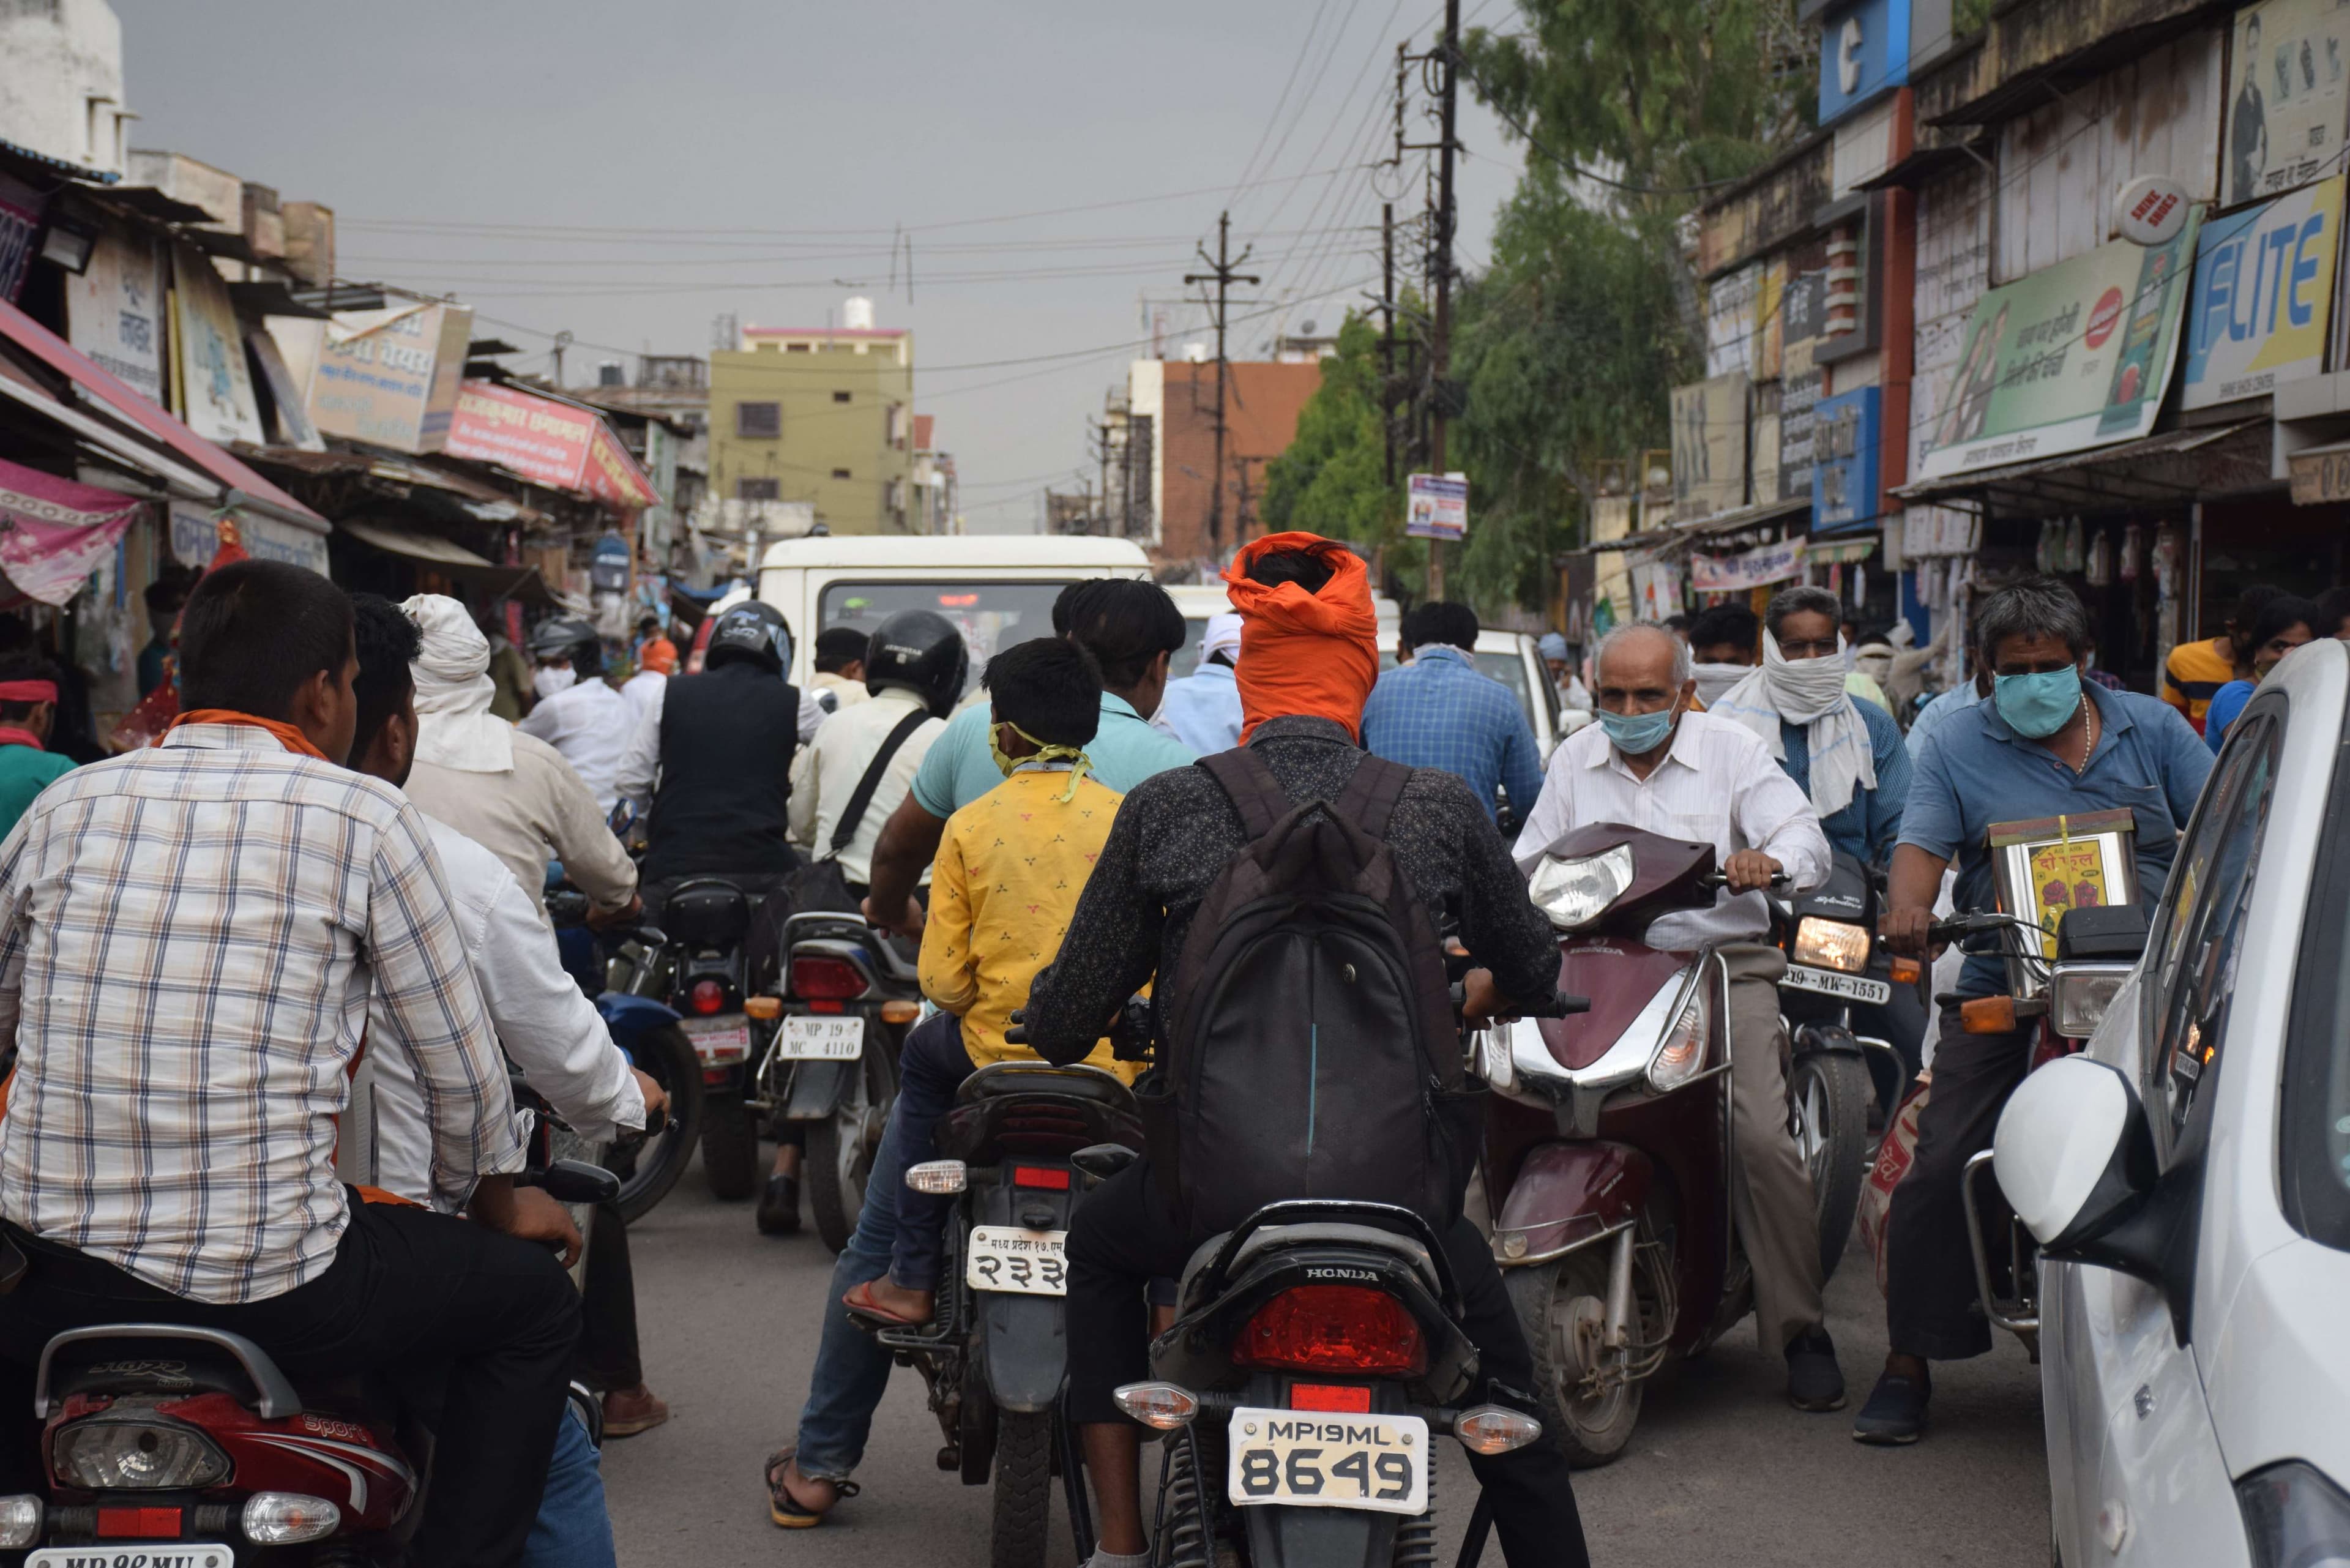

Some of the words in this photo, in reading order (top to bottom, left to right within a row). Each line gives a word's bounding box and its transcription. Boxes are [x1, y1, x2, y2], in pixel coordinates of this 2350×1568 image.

[2130, 189, 2161, 221] SHINE
[2147, 193, 2179, 227] SHOES
[2199, 212, 2324, 350] FLITE
[2039, 853, 2055, 870] दो
[1852, 982, 1884, 1000] 1551
[805, 1023, 821, 1037] MP
[829, 1023, 843, 1036] 19
[788, 1042, 807, 1054] MC
[822, 1042, 854, 1055] 4110
[991, 1239, 1009, 1249] मध्य
[1012, 1235, 1031, 1251] प्रदेश
[1307, 1269, 1379, 1281] HONDA
[1269, 1421, 1392, 1446] MP19ML
[1241, 1448, 1412, 1501] 8649
